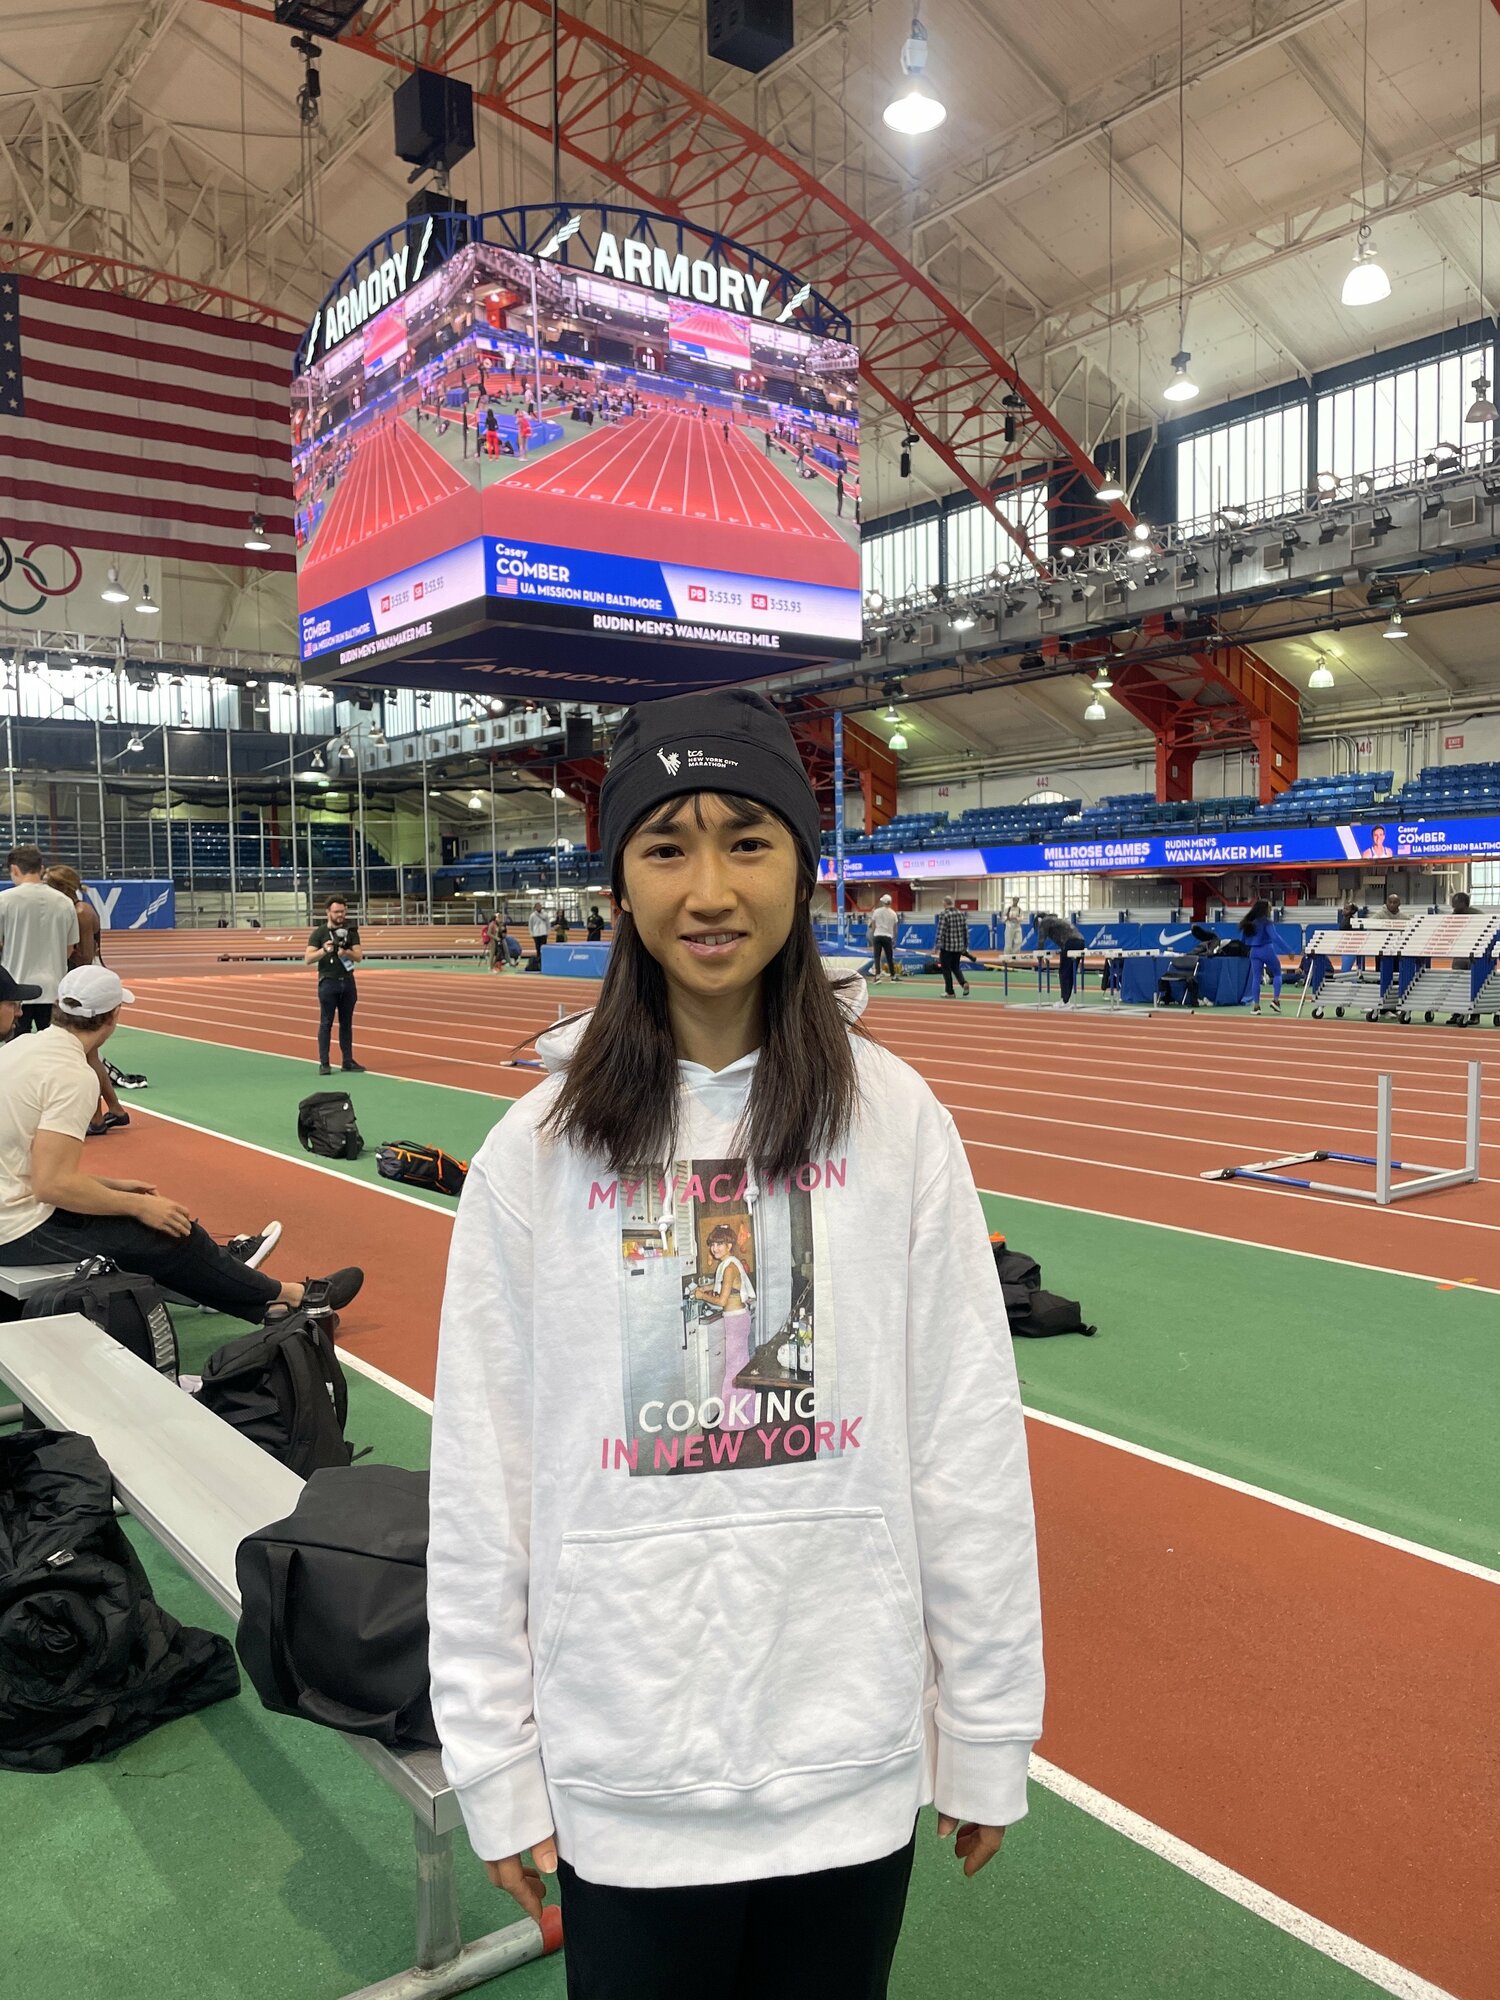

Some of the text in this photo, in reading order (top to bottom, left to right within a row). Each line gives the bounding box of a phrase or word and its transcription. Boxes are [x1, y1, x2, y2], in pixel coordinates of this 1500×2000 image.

[593, 231, 770, 317] ARMORY
[325, 245, 409, 350] ARMORY
[495, 543, 528, 560] Casey
[496, 558, 570, 583] COMBER
[520, 582, 663, 611] UA MISSION RUN BALTIMORE
[690, 589, 742, 606] PB 3:53.93
[753, 596, 801, 613] SB 3:53.93
[593, 614, 780, 648] RUDIN MEN'S WANAMAKER MILE
[461, 664, 655, 685] ARMORY
[687, 749, 703, 757] tcs
[1397, 825, 1418, 834] Casey
[1397, 832, 1446, 844] COMBER
[1044, 842, 1150, 861] MILLROSE GAMES
[1165, 837, 1216, 849] RUDIN MEN'S
[1412, 844, 1422, 853] UA
[1423, 844, 1453, 852] MISSION
[1454, 843, 1469, 851] RUN
[1114, 857, 1139, 865] CENTER
[1165, 844, 1283, 862] WANAMAKER MILE
[588, 1178, 644, 1210] MY
[639, 1387, 817, 1433] COOKING
[601, 1415, 864, 1471] IN NEW YORK
